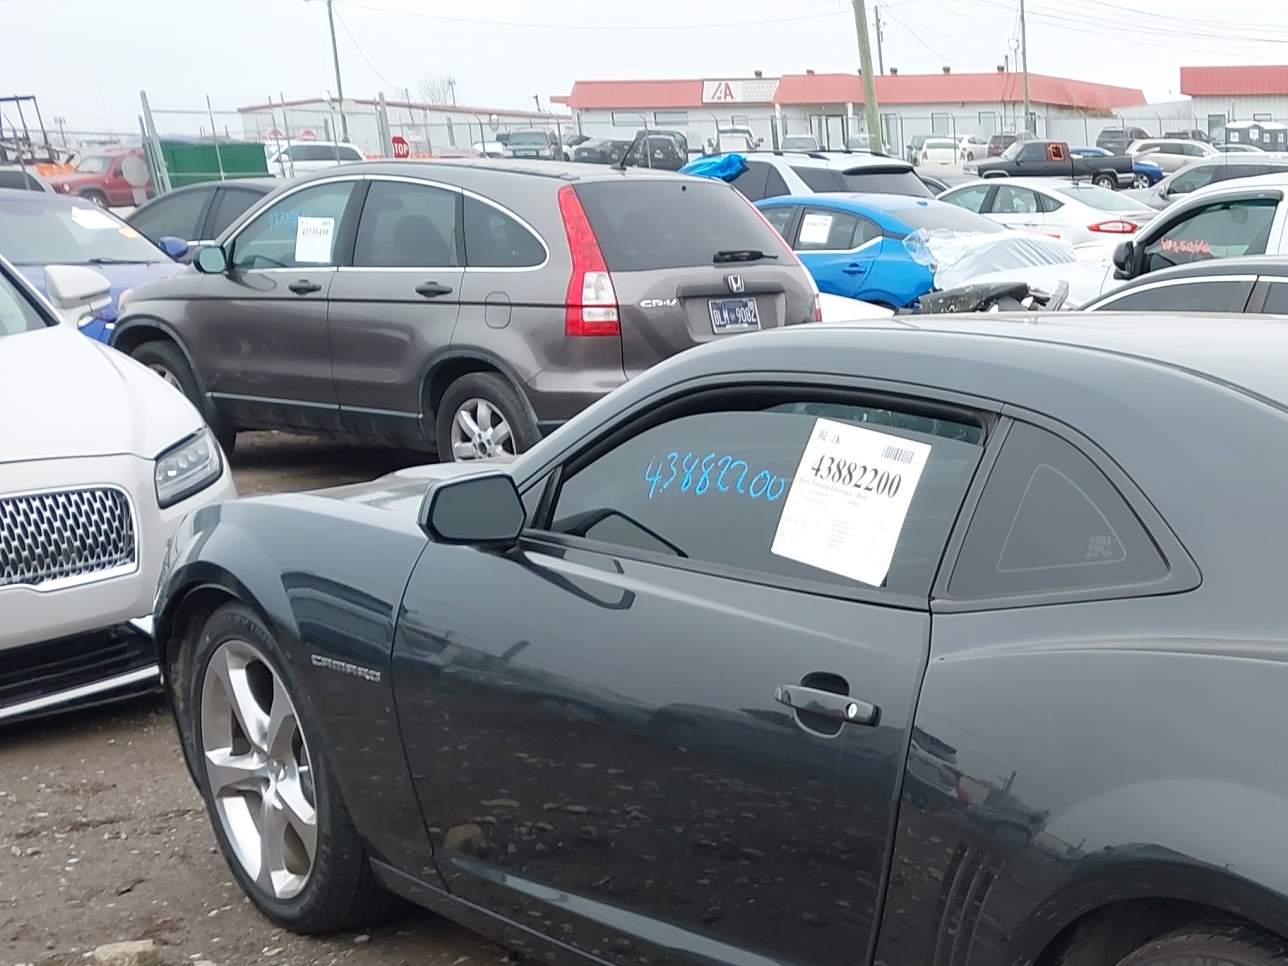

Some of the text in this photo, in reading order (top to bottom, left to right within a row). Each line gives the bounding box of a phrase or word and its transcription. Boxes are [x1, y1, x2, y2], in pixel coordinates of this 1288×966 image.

[394, 143, 408, 156] TOP
[810, 453, 903, 499] 43882200
[311, 654, 381, 683] CAMARO
